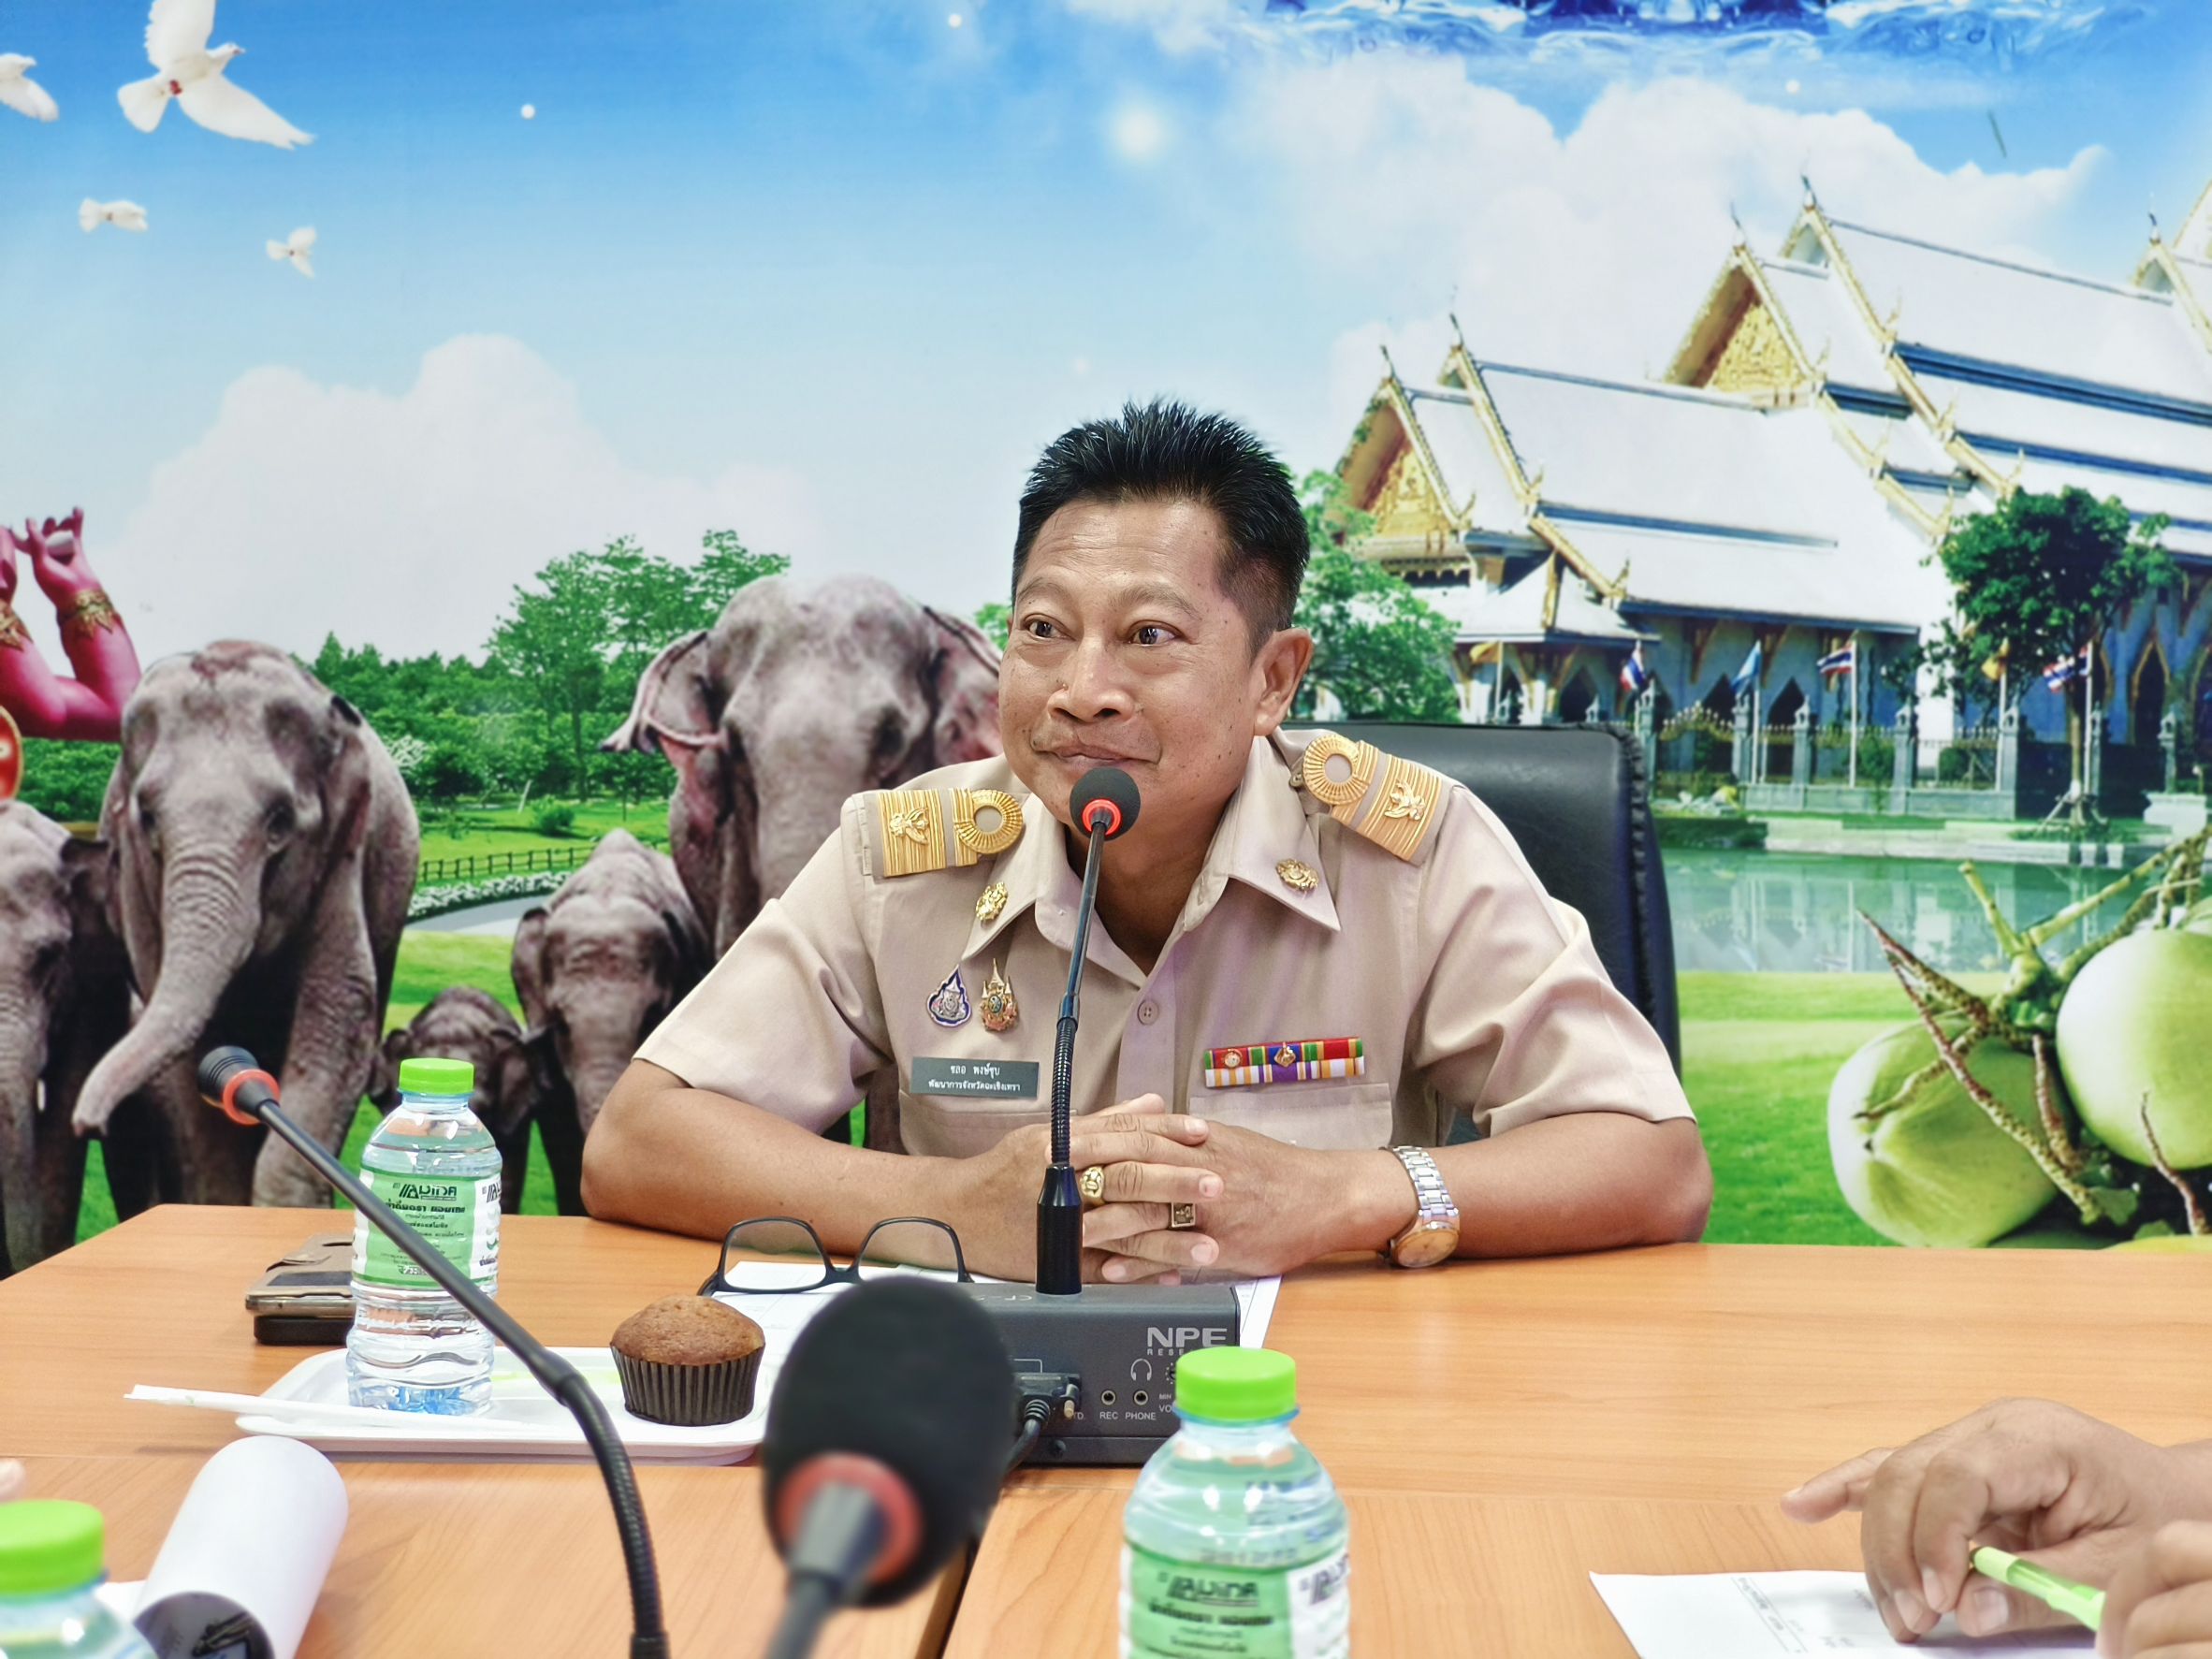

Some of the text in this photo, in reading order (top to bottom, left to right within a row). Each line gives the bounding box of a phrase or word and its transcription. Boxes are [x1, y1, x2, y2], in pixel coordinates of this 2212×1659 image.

[1147, 1327, 1228, 1348] NPE
[1158, 1404, 1173, 1413] VO
[1099, 1411, 1119, 1420] REC
[1125, 1411, 1157, 1420] PHONE
